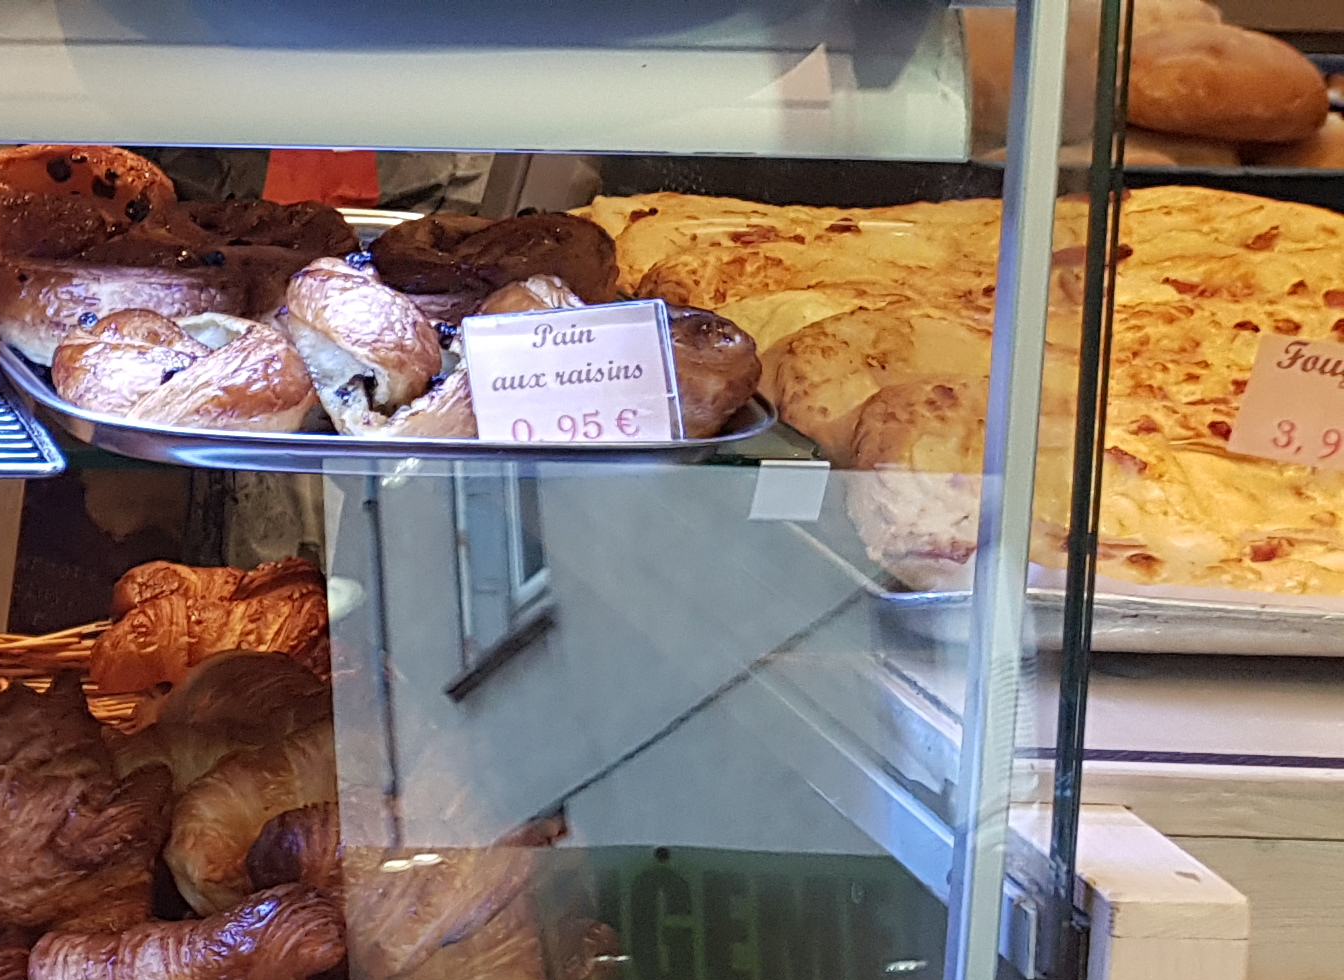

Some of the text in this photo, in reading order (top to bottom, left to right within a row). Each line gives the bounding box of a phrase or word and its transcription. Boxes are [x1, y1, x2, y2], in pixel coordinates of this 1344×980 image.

[532, 323, 596, 349] Pain
[491, 360, 644, 392] aux raisins
[1276, 340, 1344, 390] Fou
